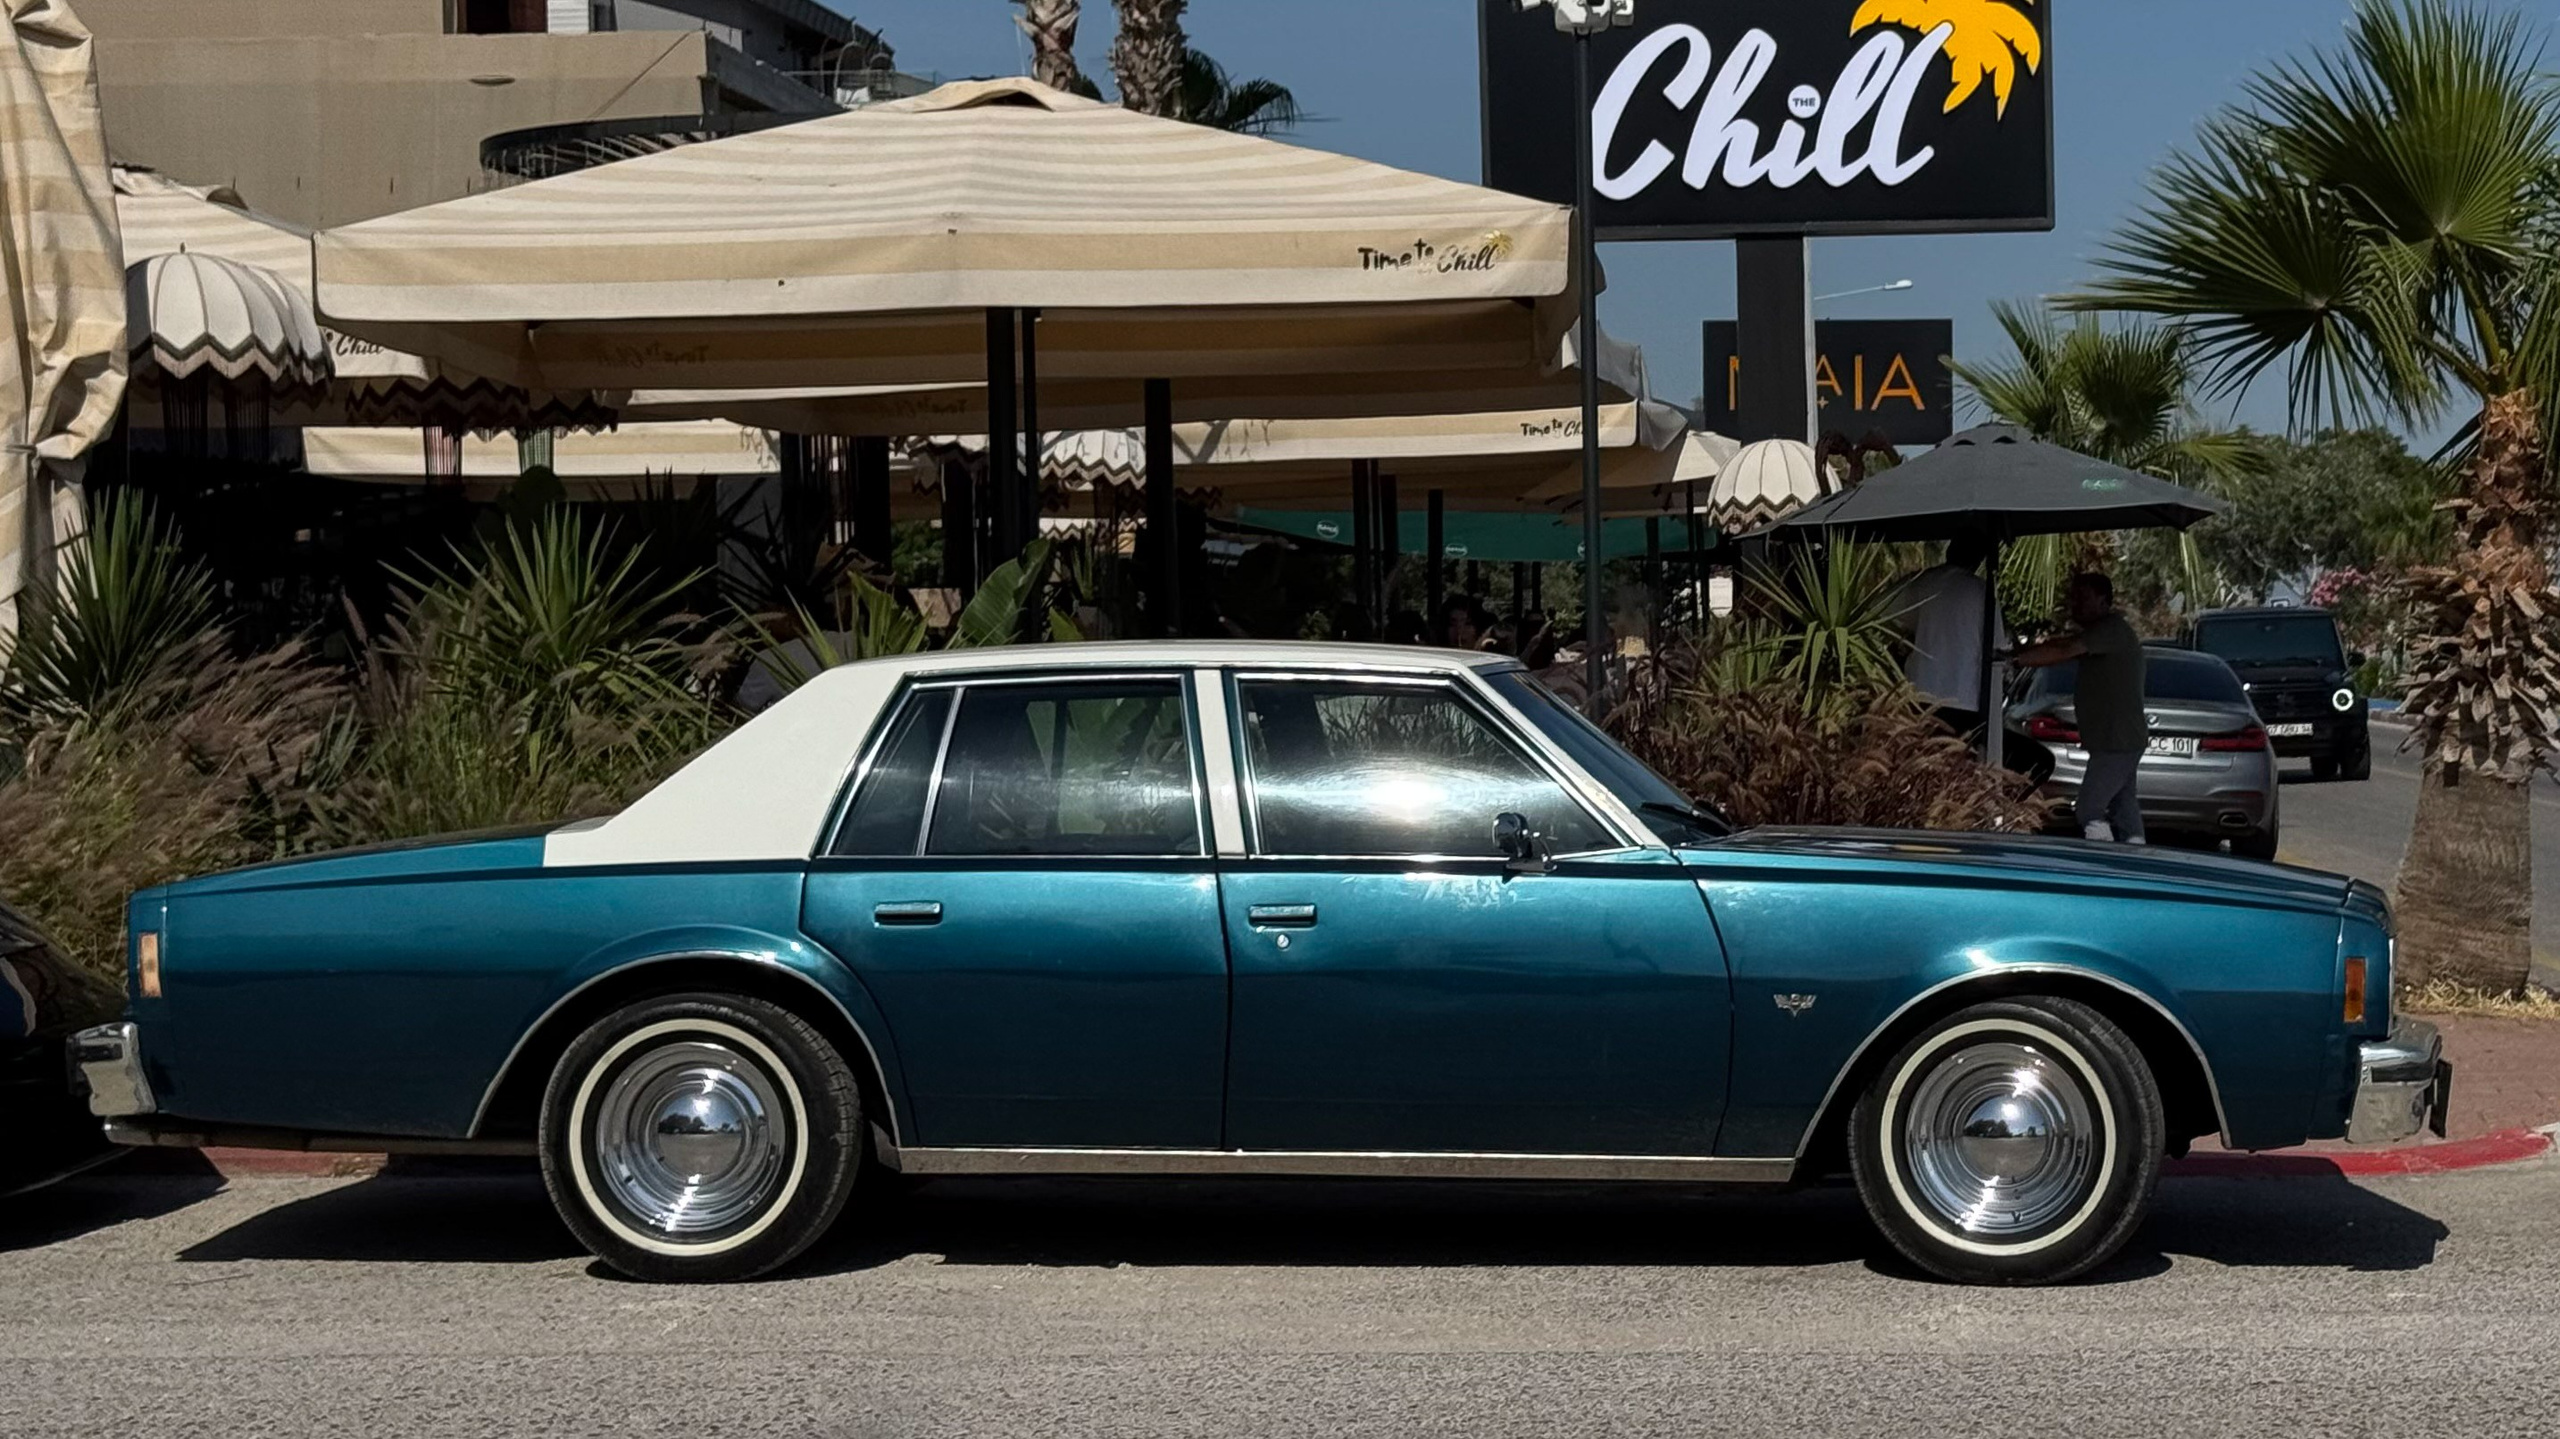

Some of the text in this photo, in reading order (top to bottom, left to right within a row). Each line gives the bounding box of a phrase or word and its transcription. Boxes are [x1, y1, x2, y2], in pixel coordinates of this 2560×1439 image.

[1592, 22, 1953, 199] Chill
[1792, 97, 1816, 107] THE
[1357, 238, 1499, 273] Time to Chill
[1729, 353, 1926, 411] AIA
[1520, 423, 1551, 437] Time
[2172, 738, 2190, 751] 101
